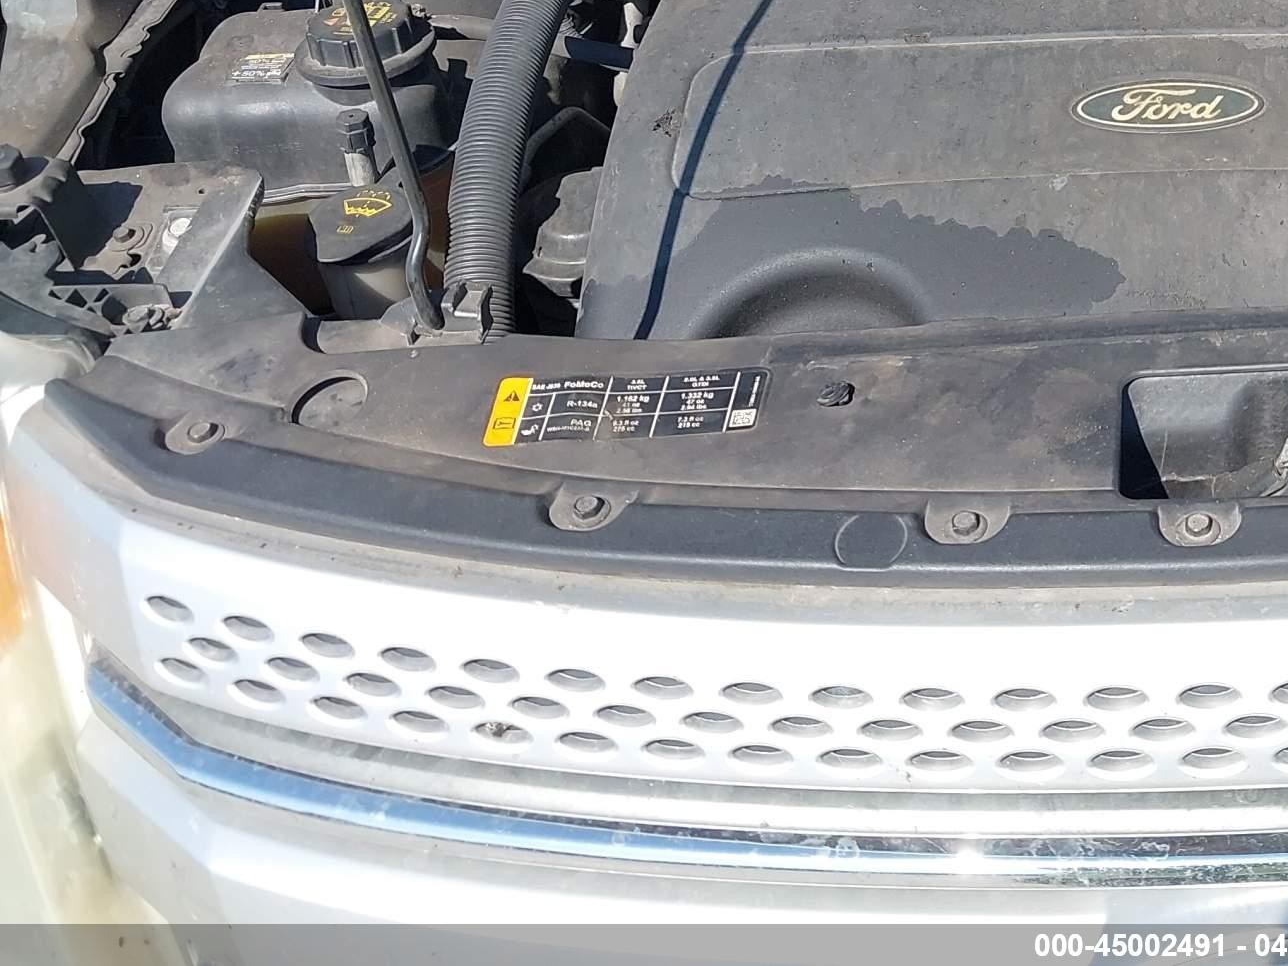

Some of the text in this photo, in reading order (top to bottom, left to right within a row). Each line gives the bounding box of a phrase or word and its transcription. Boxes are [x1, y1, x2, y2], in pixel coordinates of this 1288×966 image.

[1111, 88, 1225, 121] Ford
[564, 380, 605, 389] FoMoCo
[639, 394, 650, 403] kg
[680, 391, 715, 400] 1.332 kg
[566, 400, 598, 409] R-134a
[570, 418, 592, 427] PAG
